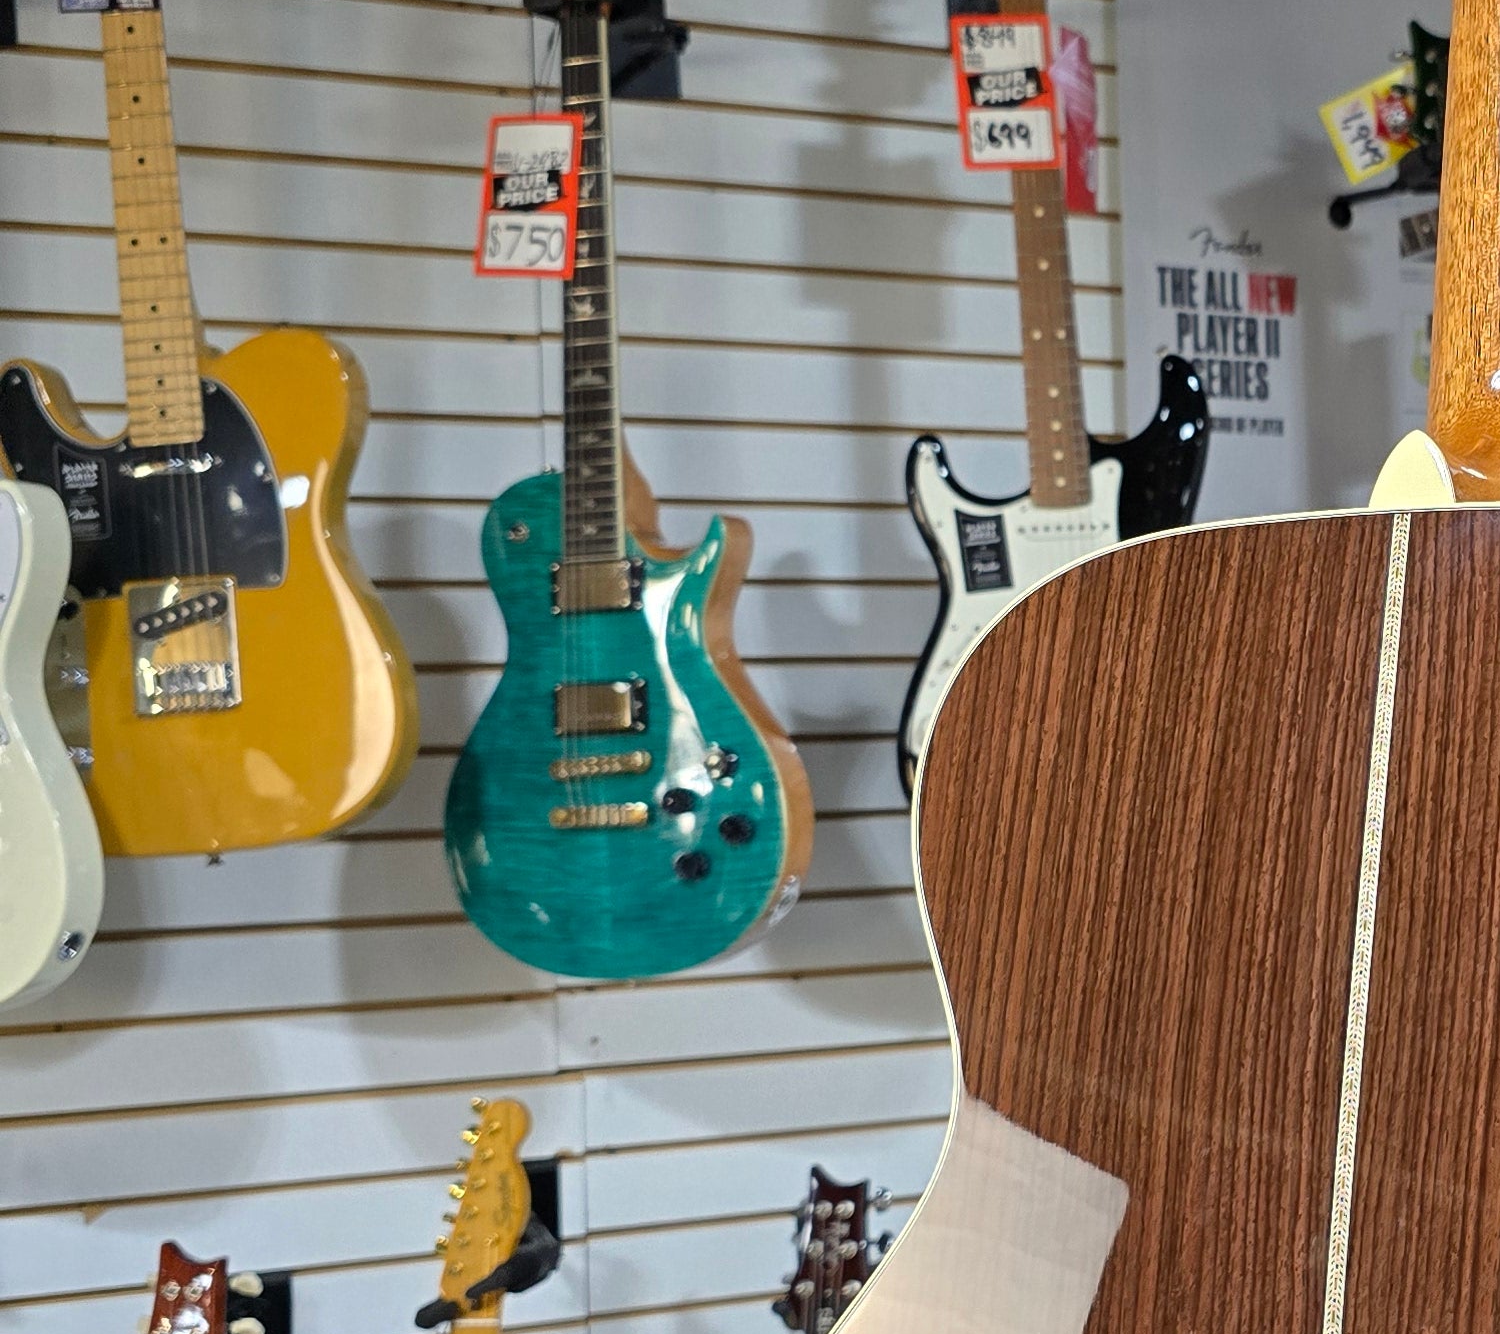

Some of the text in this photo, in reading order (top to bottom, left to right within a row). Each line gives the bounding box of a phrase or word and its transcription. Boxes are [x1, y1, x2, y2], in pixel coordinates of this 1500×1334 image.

[975, 82, 1038, 107] PRICE
[980, 70, 1027, 89] OUR
[496, 185, 560, 208] PRICE
[504, 173, 549, 190] OUR
[489, 223, 565, 267] $750
[1157, 267, 1297, 316] THE ALL NEW
[1177, 313, 1281, 359] PLAYER II
[1192, 358, 1270, 402] SERIES
